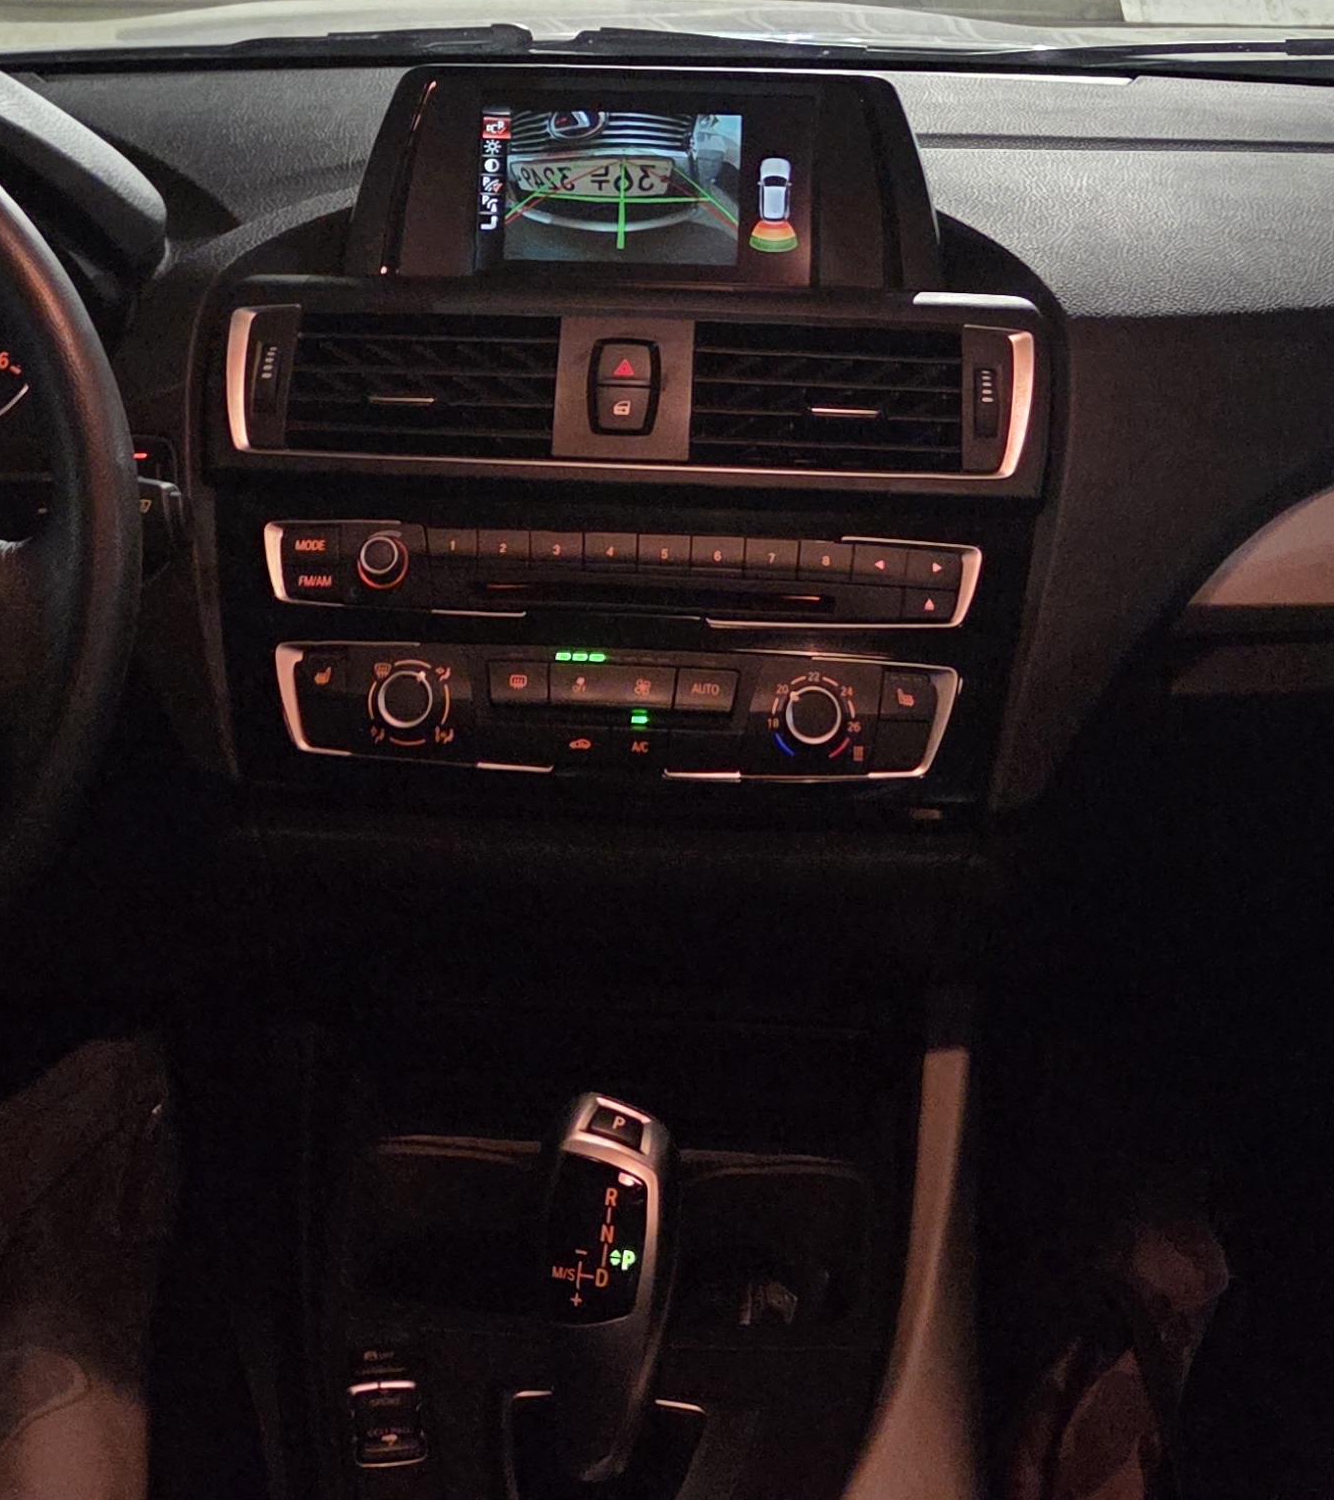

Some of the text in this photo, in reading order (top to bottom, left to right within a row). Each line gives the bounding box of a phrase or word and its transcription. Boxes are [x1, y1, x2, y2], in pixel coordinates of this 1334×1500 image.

[295, 539, 326, 552] MODE
[450, 540, 456, 551] 1
[499, 543, 507, 553] 2
[552, 544, 561, 556] 3
[606, 546, 615, 557] 4
[660, 548, 668, 560] 5
[713, 550, 722, 562] 6
[767, 552, 775, 564] 7
[821, 555, 831, 567] 8
[298, 575, 332, 587] FM/AM
[807, 672, 820, 682] 22
[691, 683, 720, 695] AUTO
[776, 684, 789, 694] 20
[840, 687, 854, 697] 24
[768, 719, 779, 728] 18
[847, 722, 861, 732] 26
[631, 741, 650, 754] A/C
[612, 1116, 625, 1130] P
[605, 1188, 617, 1206] R
[600, 1225, 613, 1243] N
[622, 1250, 636, 1270] P
[552, 1266, 575, 1281] M/S
[595, 1268, 608, 1287] D
